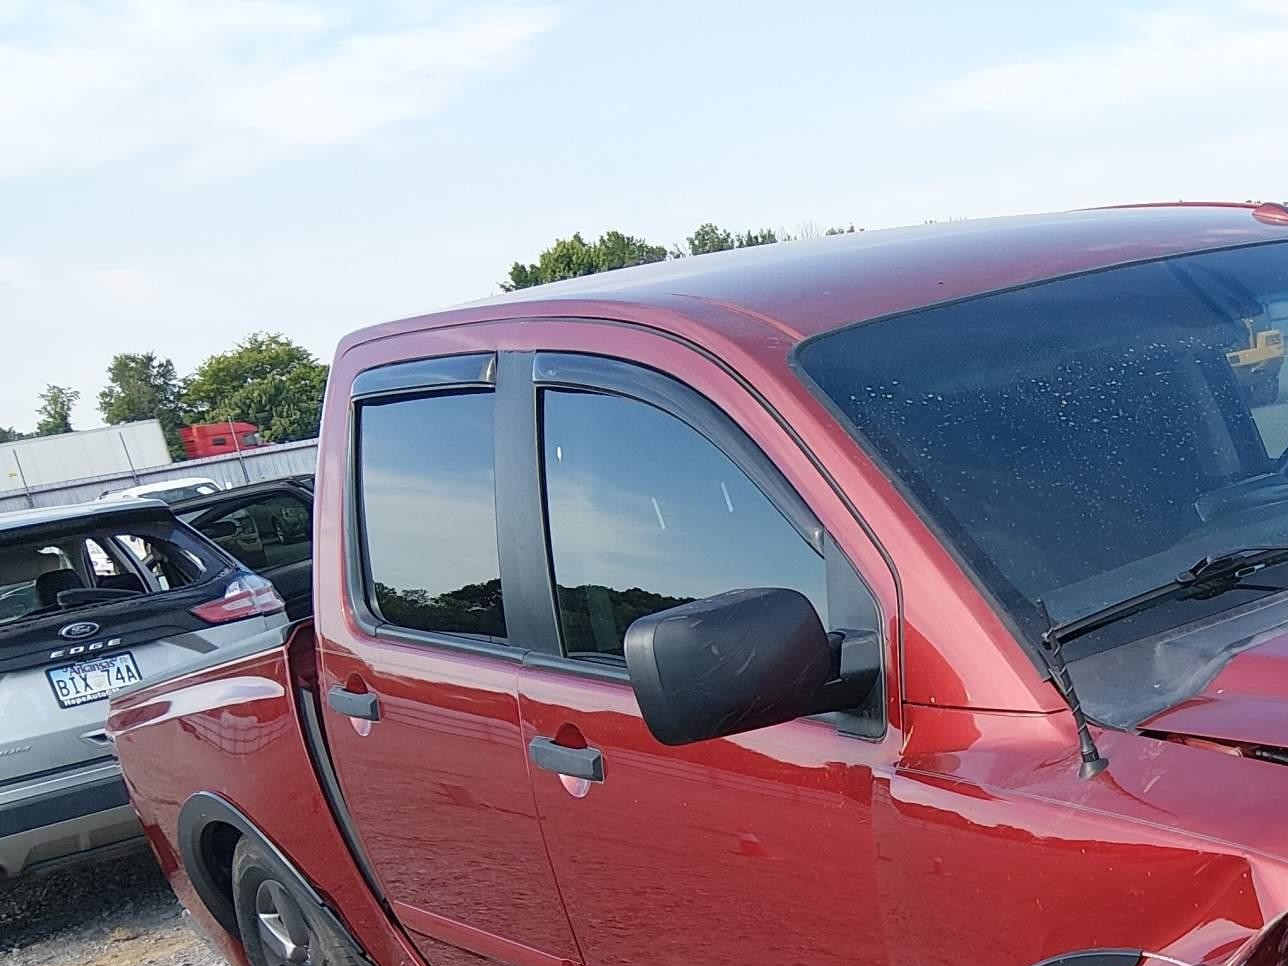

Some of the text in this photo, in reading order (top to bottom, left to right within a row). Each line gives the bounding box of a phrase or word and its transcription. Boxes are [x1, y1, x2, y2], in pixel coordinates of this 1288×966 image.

[49, 638, 122, 659] EDGE
[69, 660, 116, 676] Arkansas
[56, 664, 138, 698] BIX 74A
